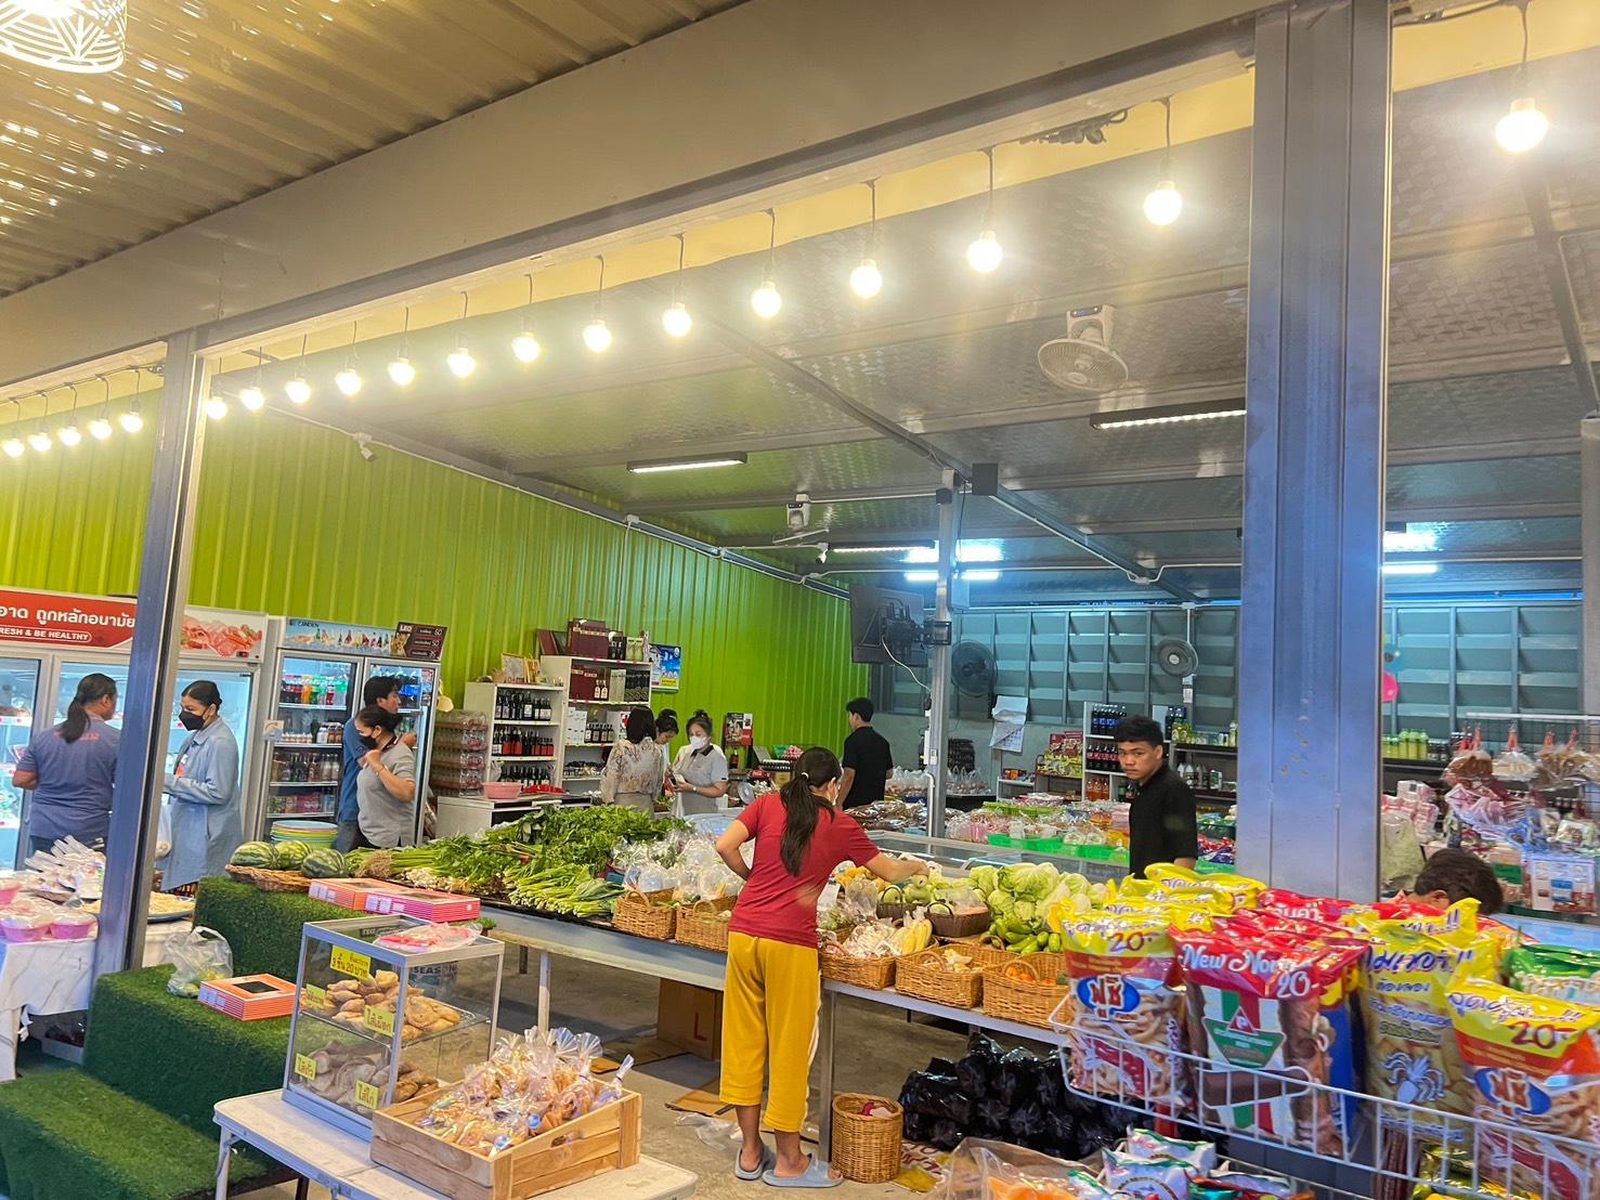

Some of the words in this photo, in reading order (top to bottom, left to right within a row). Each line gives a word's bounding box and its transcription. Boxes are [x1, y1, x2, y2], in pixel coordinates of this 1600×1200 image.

[36, 607, 136, 628] ถูกหลักอนามัย
[25, 628, 32, 636] &
[34, 629, 46, 638] BE
[48, 631, 89, 641] HEALTHY
[400, 624, 413, 632] LEO
[1178, 944, 1225, 971] New
